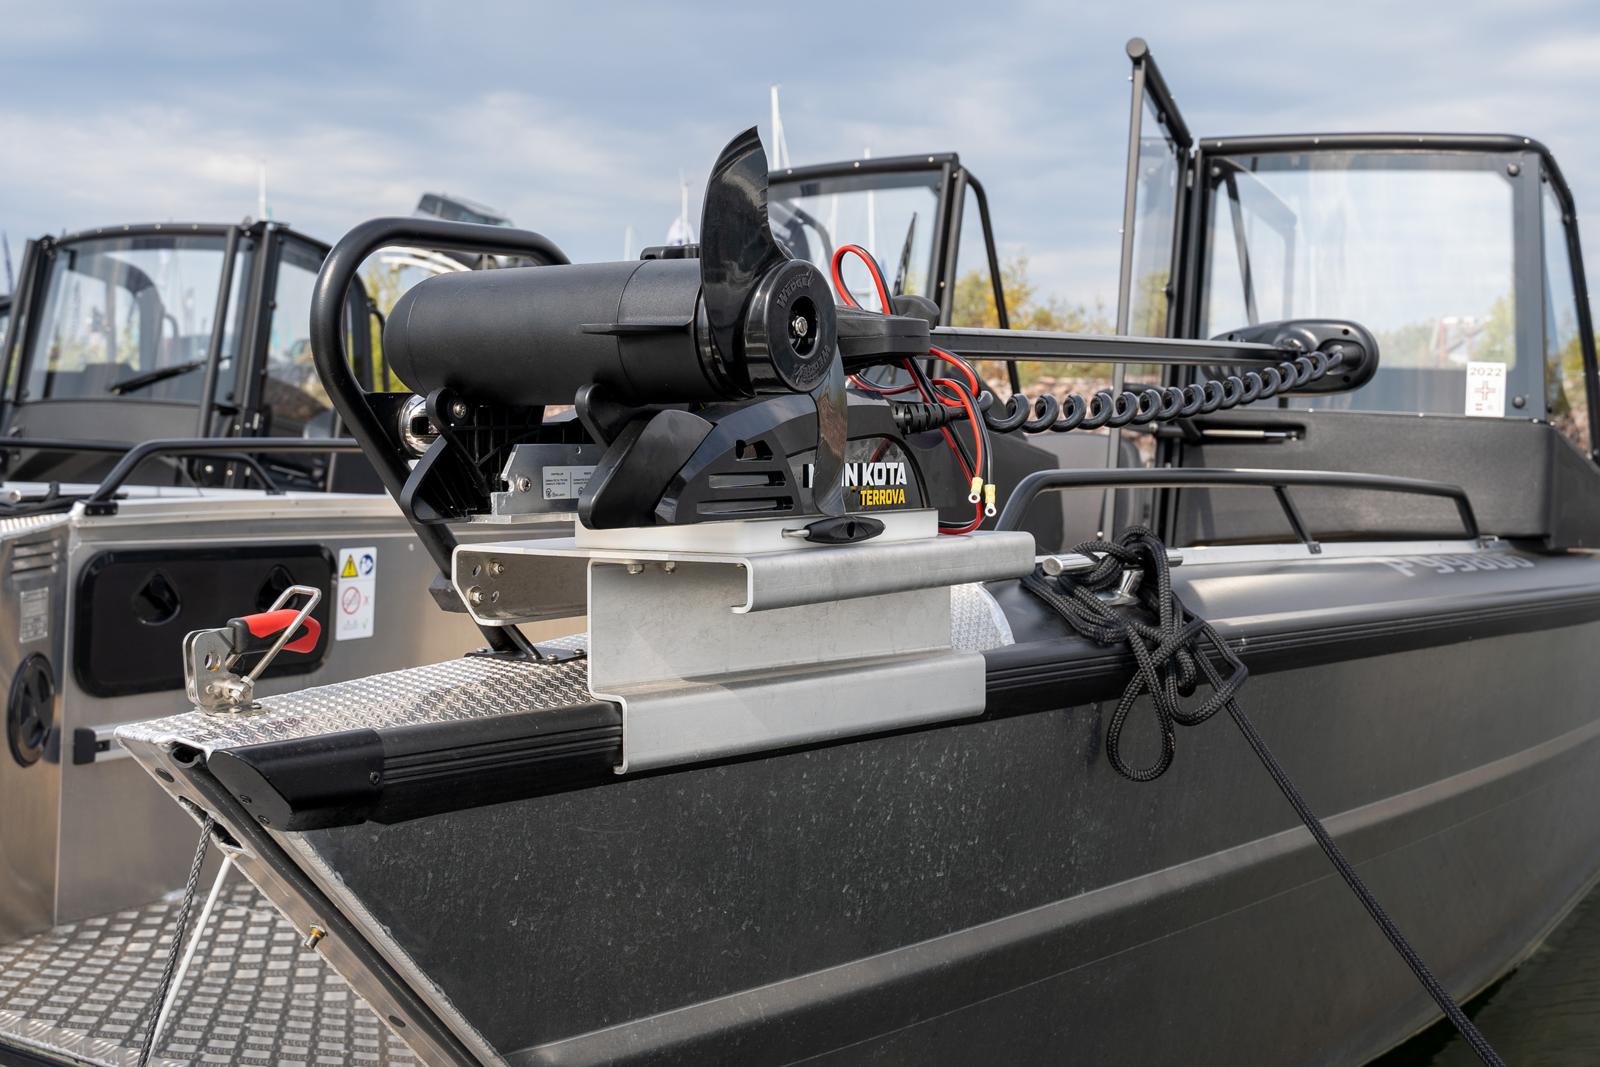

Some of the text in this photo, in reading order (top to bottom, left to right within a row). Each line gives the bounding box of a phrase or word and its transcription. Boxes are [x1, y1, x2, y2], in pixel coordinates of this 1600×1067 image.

[1470, 367, 1502, 376] 2022
[862, 462, 908, 487] KOTA
[860, 488, 906, 506] TERROVA
